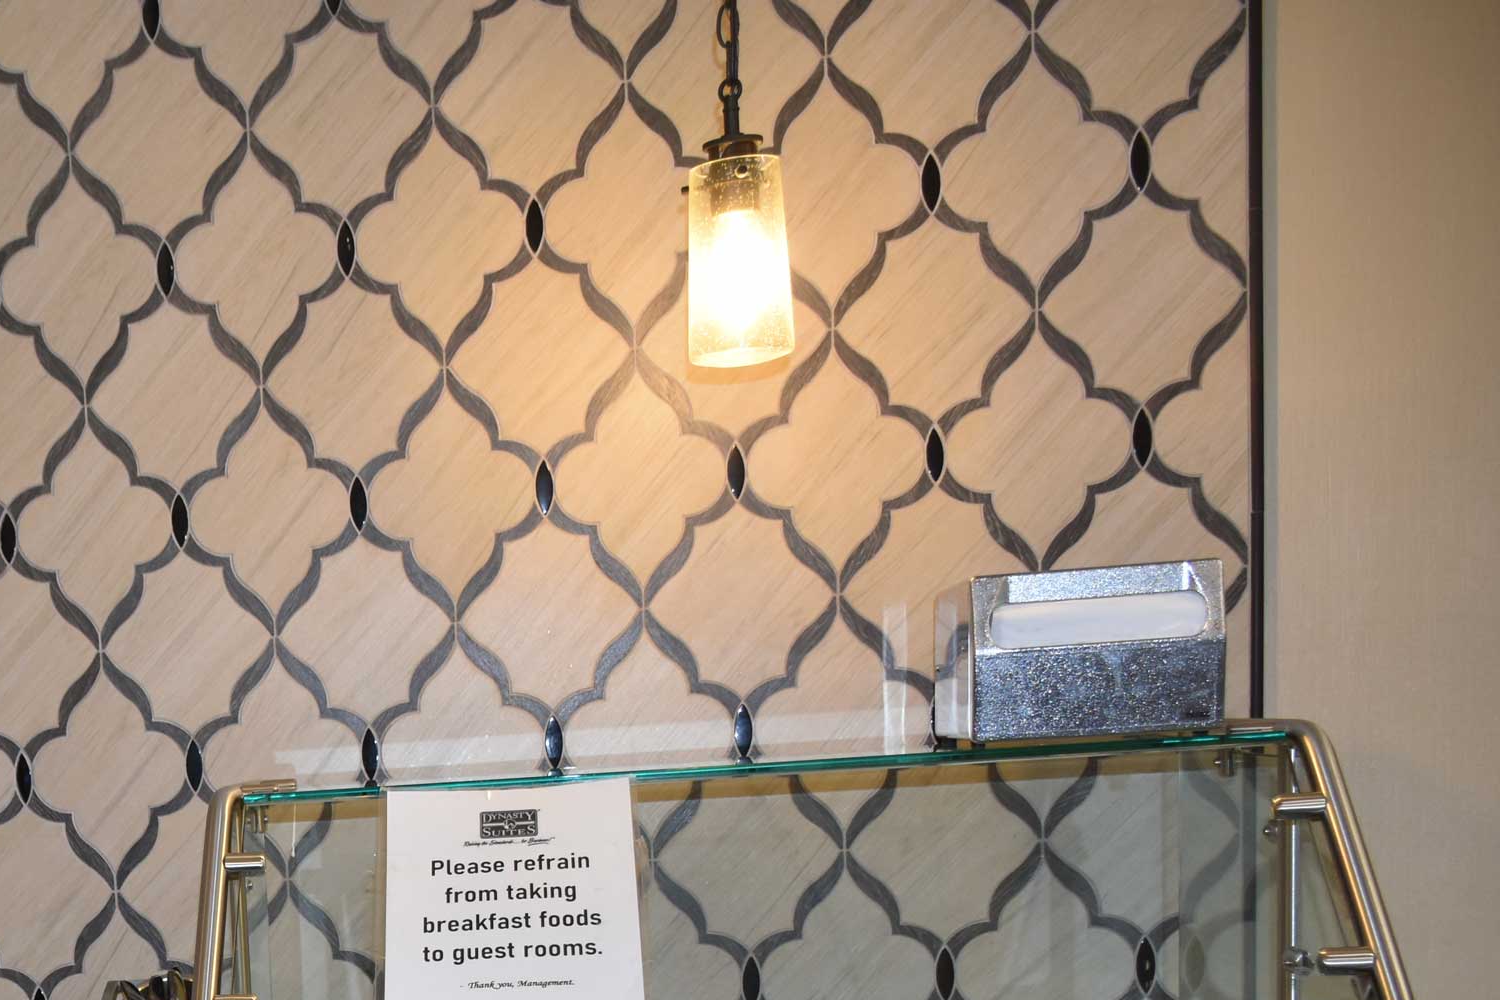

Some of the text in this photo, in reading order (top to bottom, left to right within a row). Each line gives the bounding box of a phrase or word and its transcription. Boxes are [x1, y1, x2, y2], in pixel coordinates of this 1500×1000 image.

[482, 810, 535, 823] DYNASTY
[482, 824, 536, 837] SUITES
[431, 852, 590, 876] Please refrain
[445, 882, 577, 904] from taking
[423, 909, 602, 934] breakfast foods
[422, 940, 603, 965] to guest rooms.
[468, 981, 494, 989] Thank
[517, 979, 575, 989] Management.
